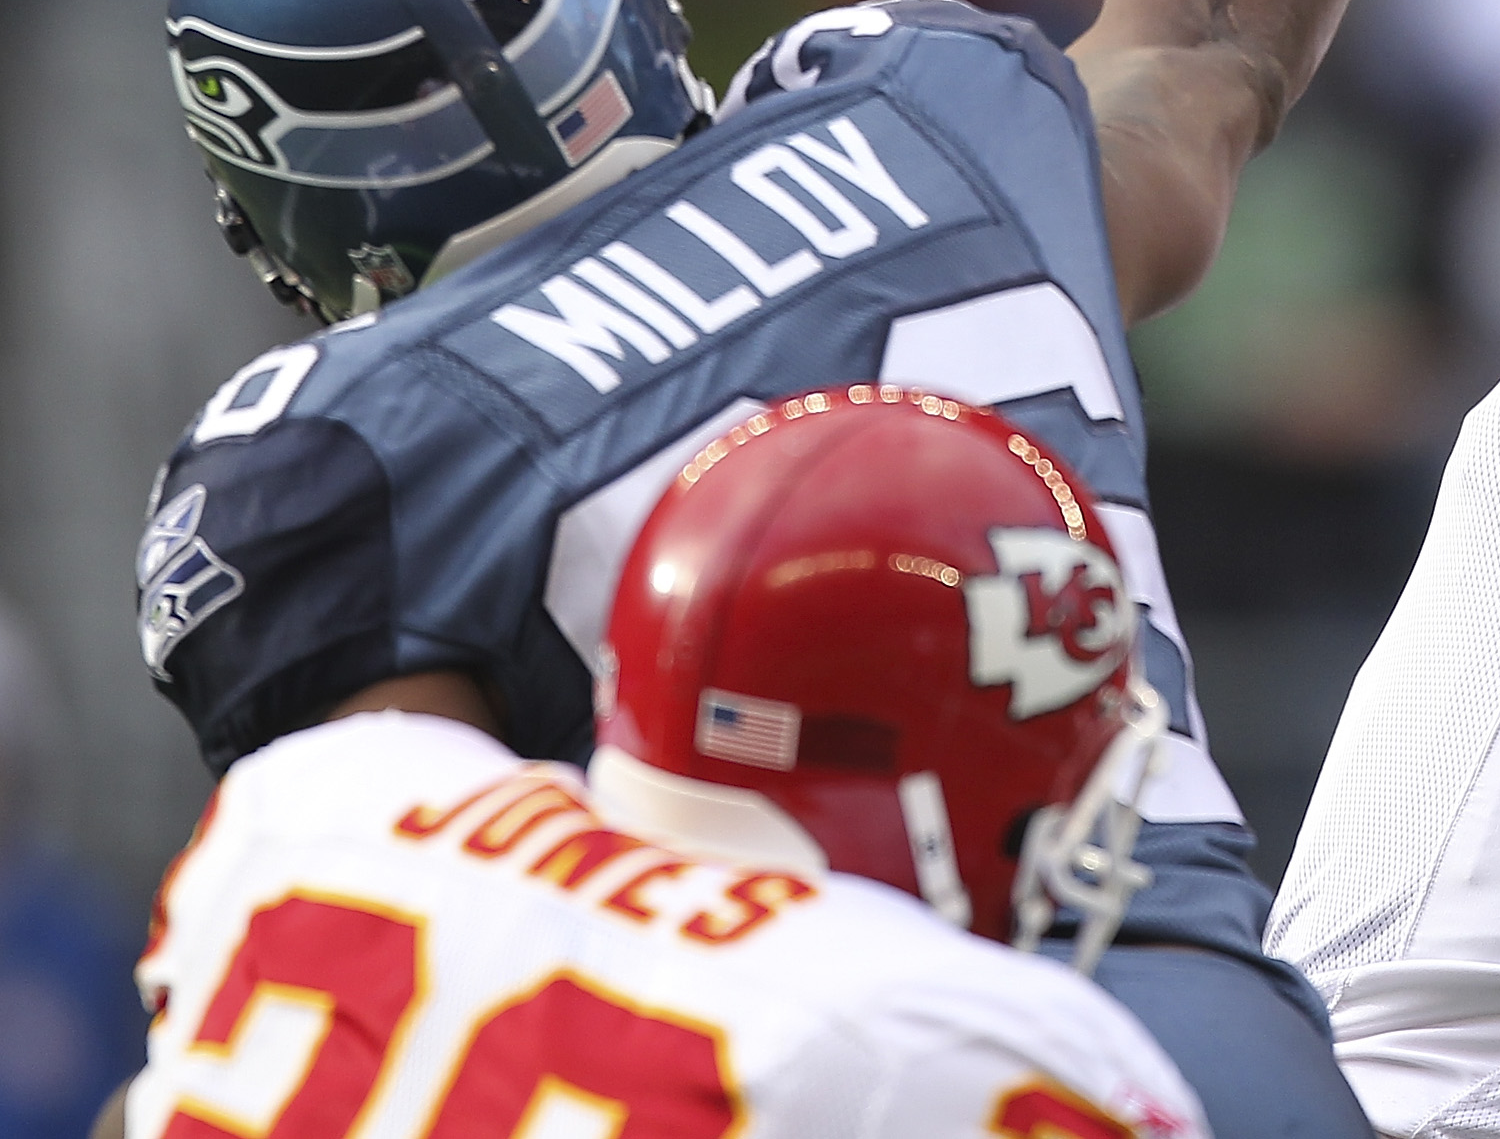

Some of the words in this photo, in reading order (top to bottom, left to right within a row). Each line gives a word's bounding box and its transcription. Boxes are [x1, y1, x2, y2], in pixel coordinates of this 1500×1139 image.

[490, 115, 930, 395] MILLOY
[1017, 563, 1130, 665] KC
[393, 765, 818, 945] JONES
